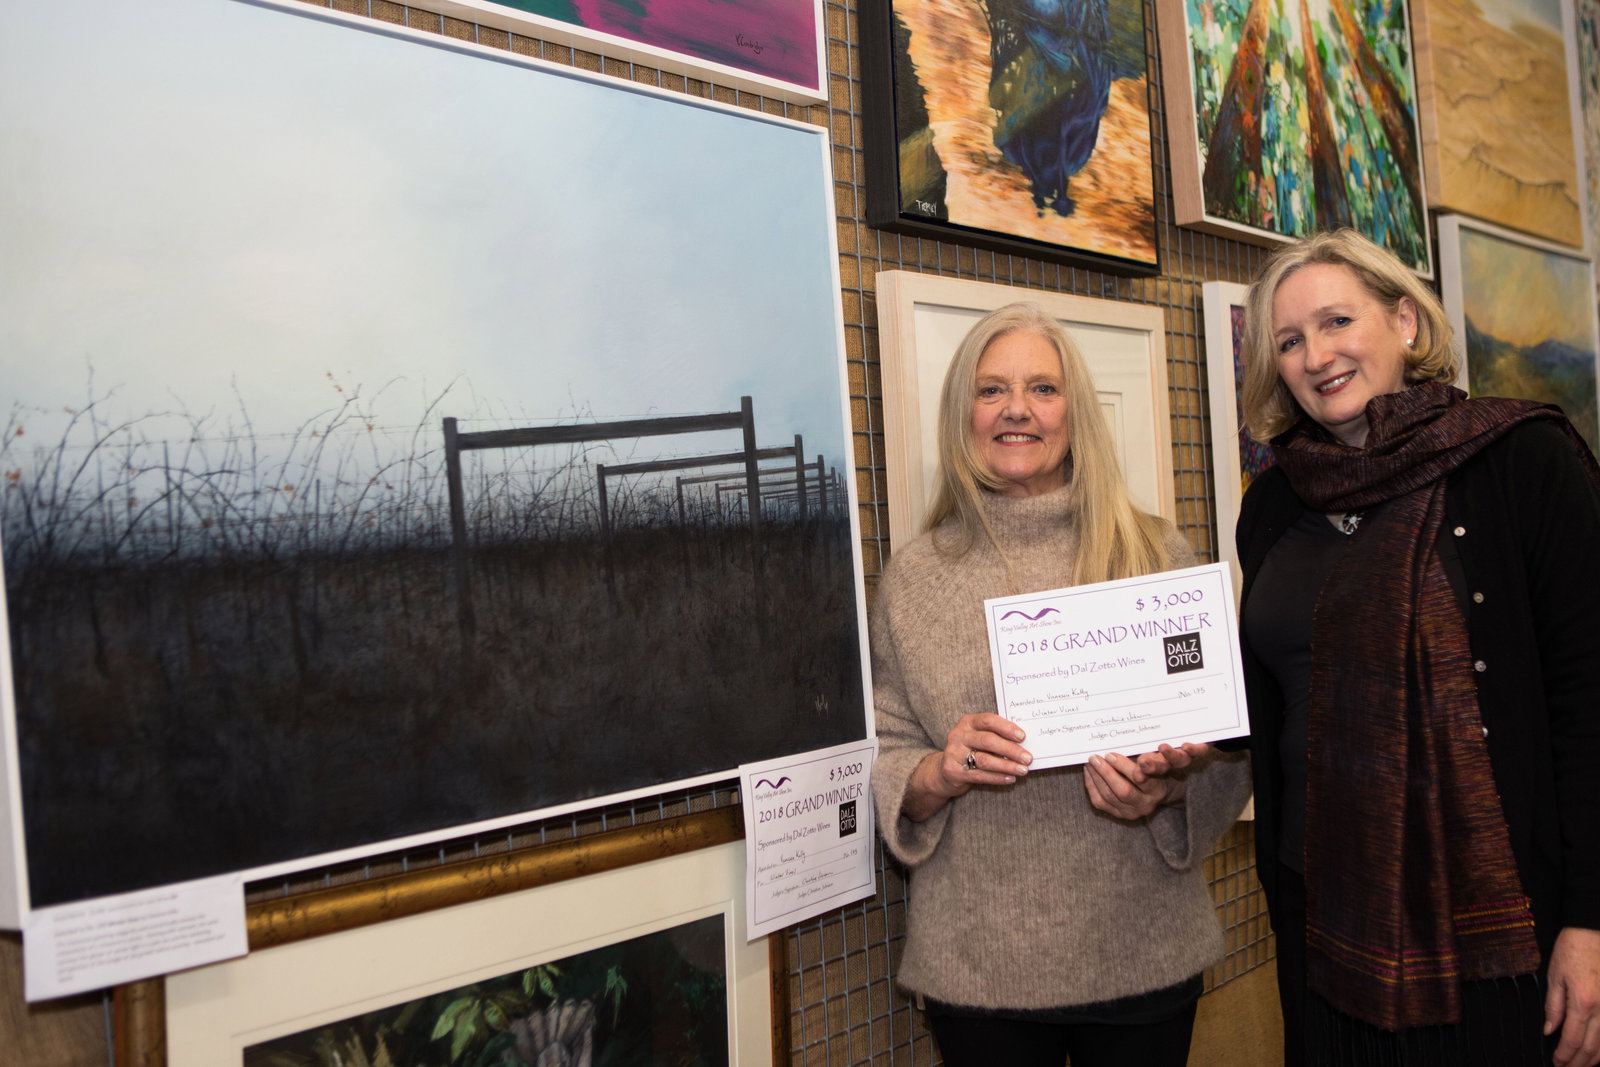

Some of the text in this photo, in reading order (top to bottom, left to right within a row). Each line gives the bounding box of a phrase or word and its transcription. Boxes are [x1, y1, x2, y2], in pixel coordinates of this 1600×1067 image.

[1135, 589, 1203, 611] $ 3,000
[1007, 612, 1212, 655] 2018 GRAND WINNER
[1014, 622, 1028, 632] Valley
[1029, 621, 1038, 629] Art
[1167, 639, 1198, 655] DALZ
[1168, 652, 1201, 667] OTTO
[1006, 656, 1146, 685] Sponsored by Dal Zotto Wines
[1010, 698, 1035, 707] Awarded
[837, 762, 863, 781] 3,000
[759, 782, 863, 823] 2018 GRAND WINNER
[840, 806, 855, 820] DALZ
[757, 835, 785, 852] Sponsored
